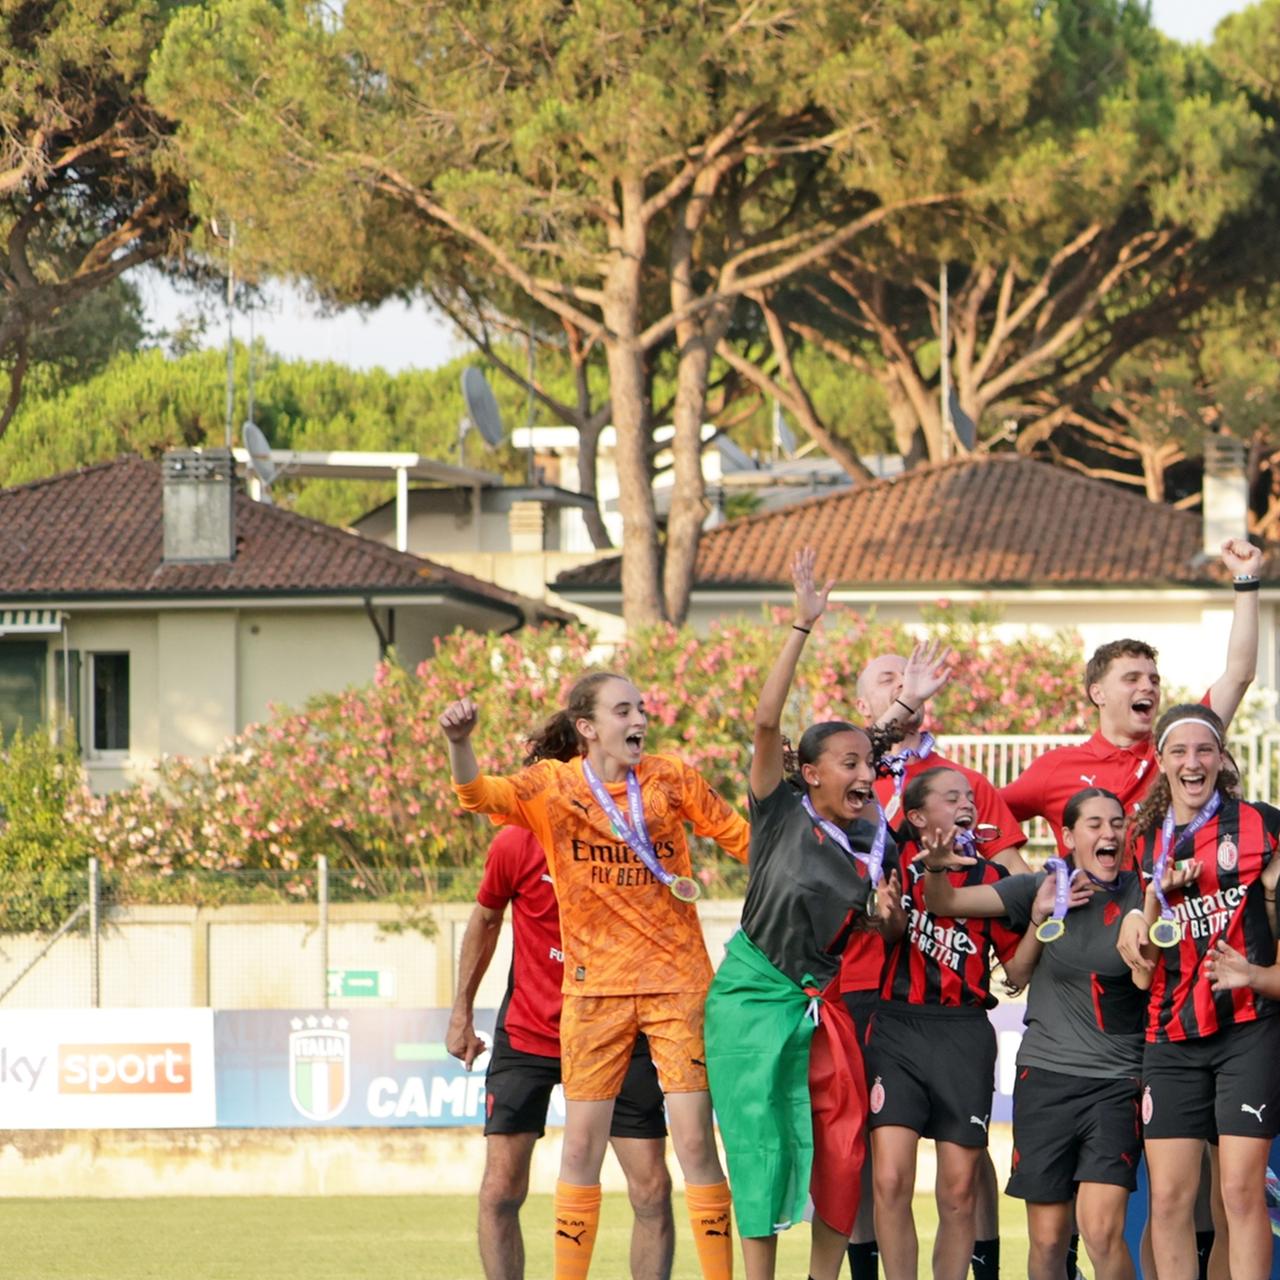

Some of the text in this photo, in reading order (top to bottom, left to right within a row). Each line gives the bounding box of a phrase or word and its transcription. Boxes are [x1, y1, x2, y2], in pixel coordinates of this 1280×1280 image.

[591, 866, 611, 884] FLY
[296, 1037, 344, 1057] ITALIA
[0, 1048, 185, 1092] ky sport
